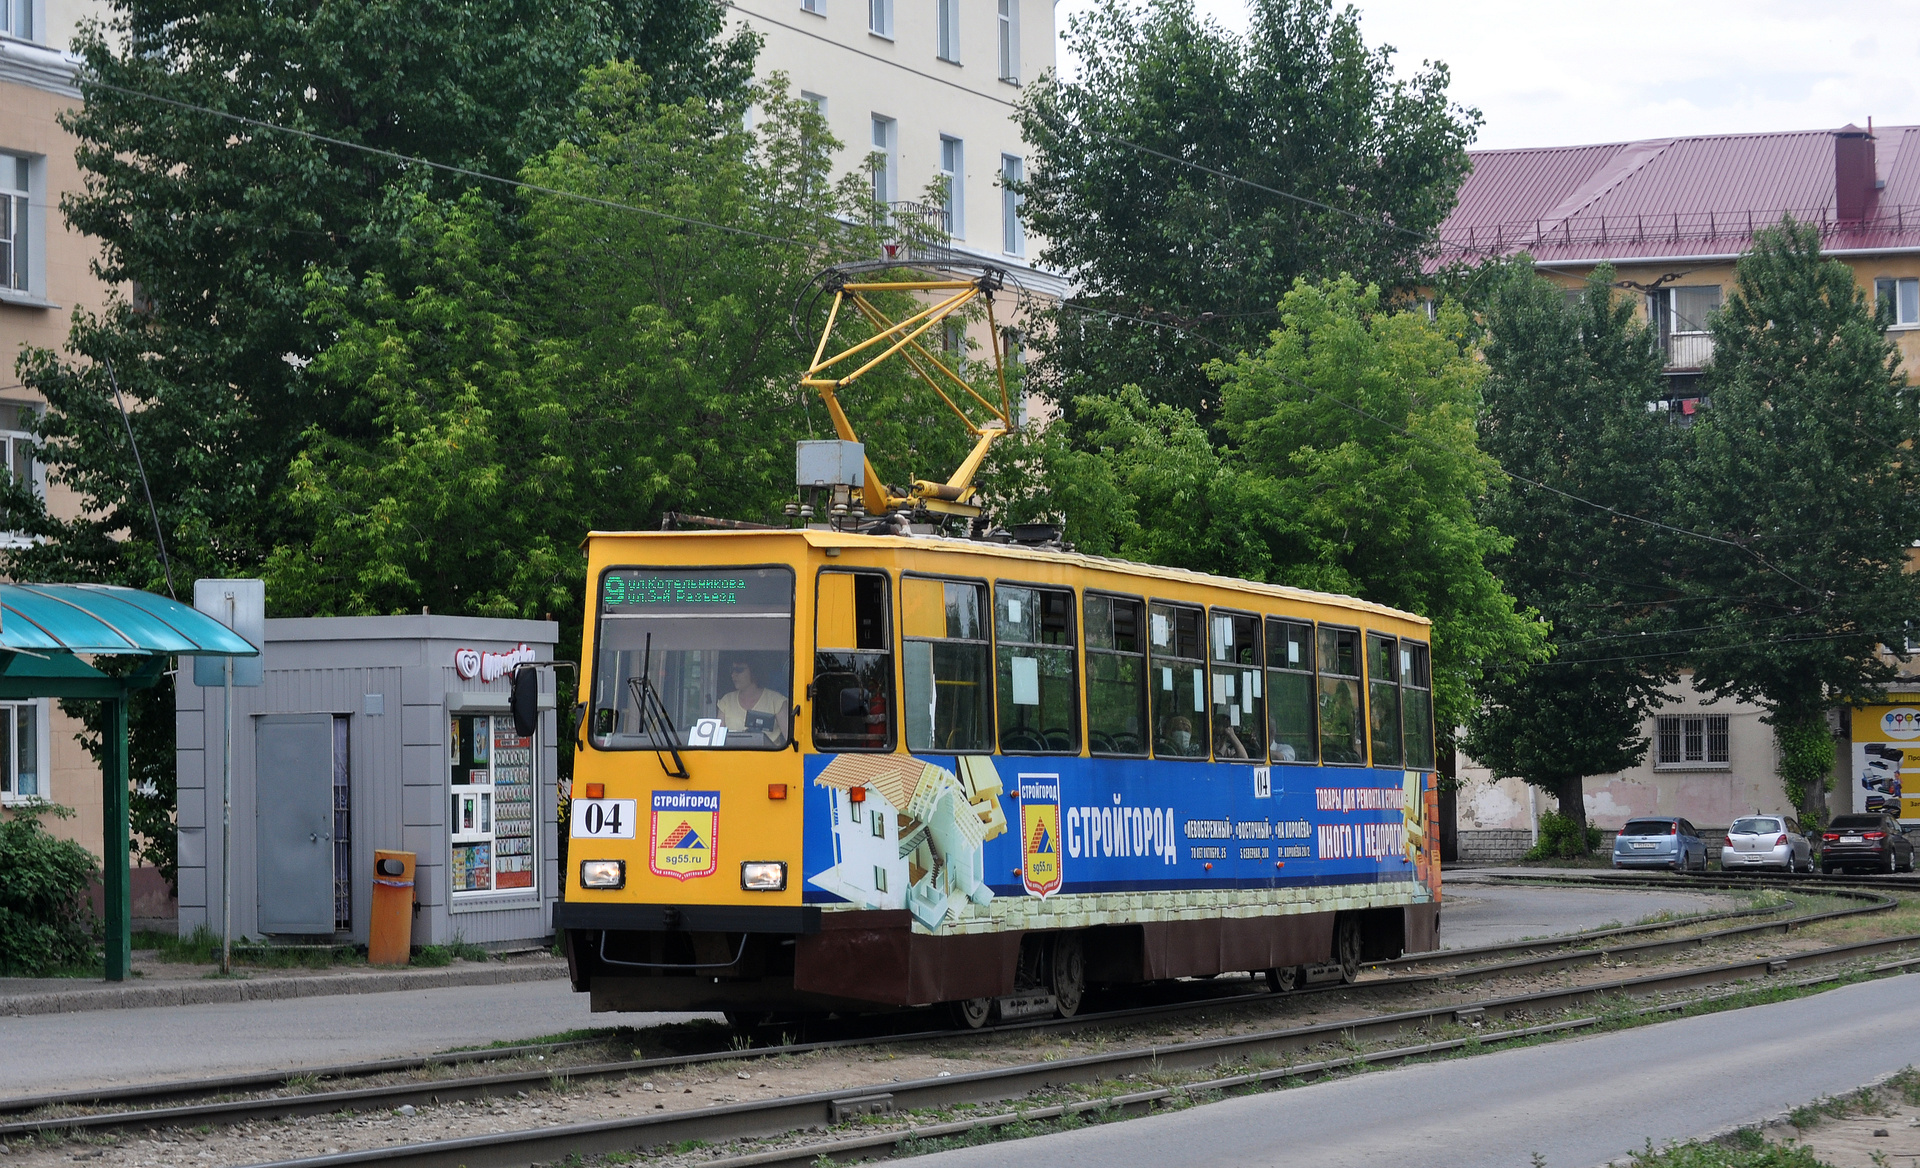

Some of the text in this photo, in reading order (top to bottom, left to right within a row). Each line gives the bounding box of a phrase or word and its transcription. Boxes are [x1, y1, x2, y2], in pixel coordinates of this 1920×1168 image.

[605, 576, 625, 605] 9
[676, 590, 736, 604] Разъезд
[697, 721, 716, 746] 9
[1021, 782, 1058, 801] СТРОЙГОРОД
[1257, 770, 1268, 795] 04
[654, 793, 718, 809] СТРОЙГОРОД
[1316, 788, 1342, 810] ТОВАРЫ
[1342, 788, 1356, 814] ДЛЯ
[1356, 788, 1381, 810] РЕМОНТА
[585, 803, 622, 834] 04
[1067, 793, 1177, 865] СТРОЙГОРОД
[1317, 824, 1353, 859] МНОГО
[1354, 824, 1363, 858] И
[665, 854, 702, 865] sg55.ru
[1033, 861, 1053, 875] sg55.ru
